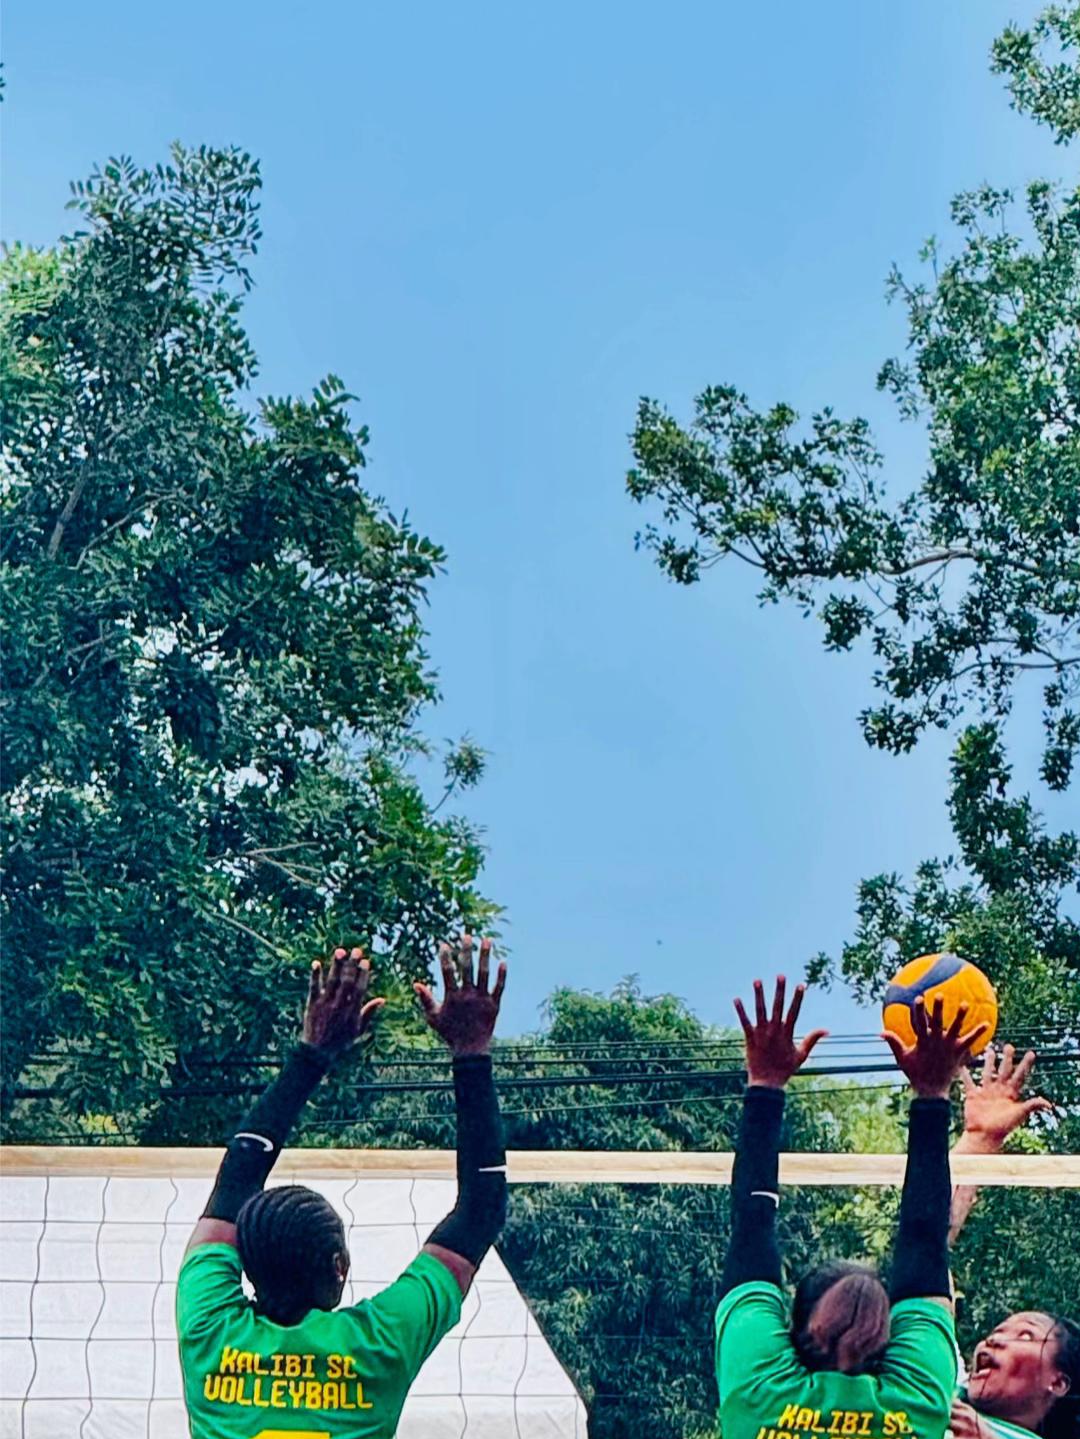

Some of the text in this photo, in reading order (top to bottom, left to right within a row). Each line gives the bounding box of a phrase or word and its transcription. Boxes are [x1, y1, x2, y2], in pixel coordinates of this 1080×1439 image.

[219, 1345, 358, 1379] KALIBI SC
[204, 1374, 373, 1409] VOLLEYBALL
[778, 1403, 874, 1435] KALIBI
